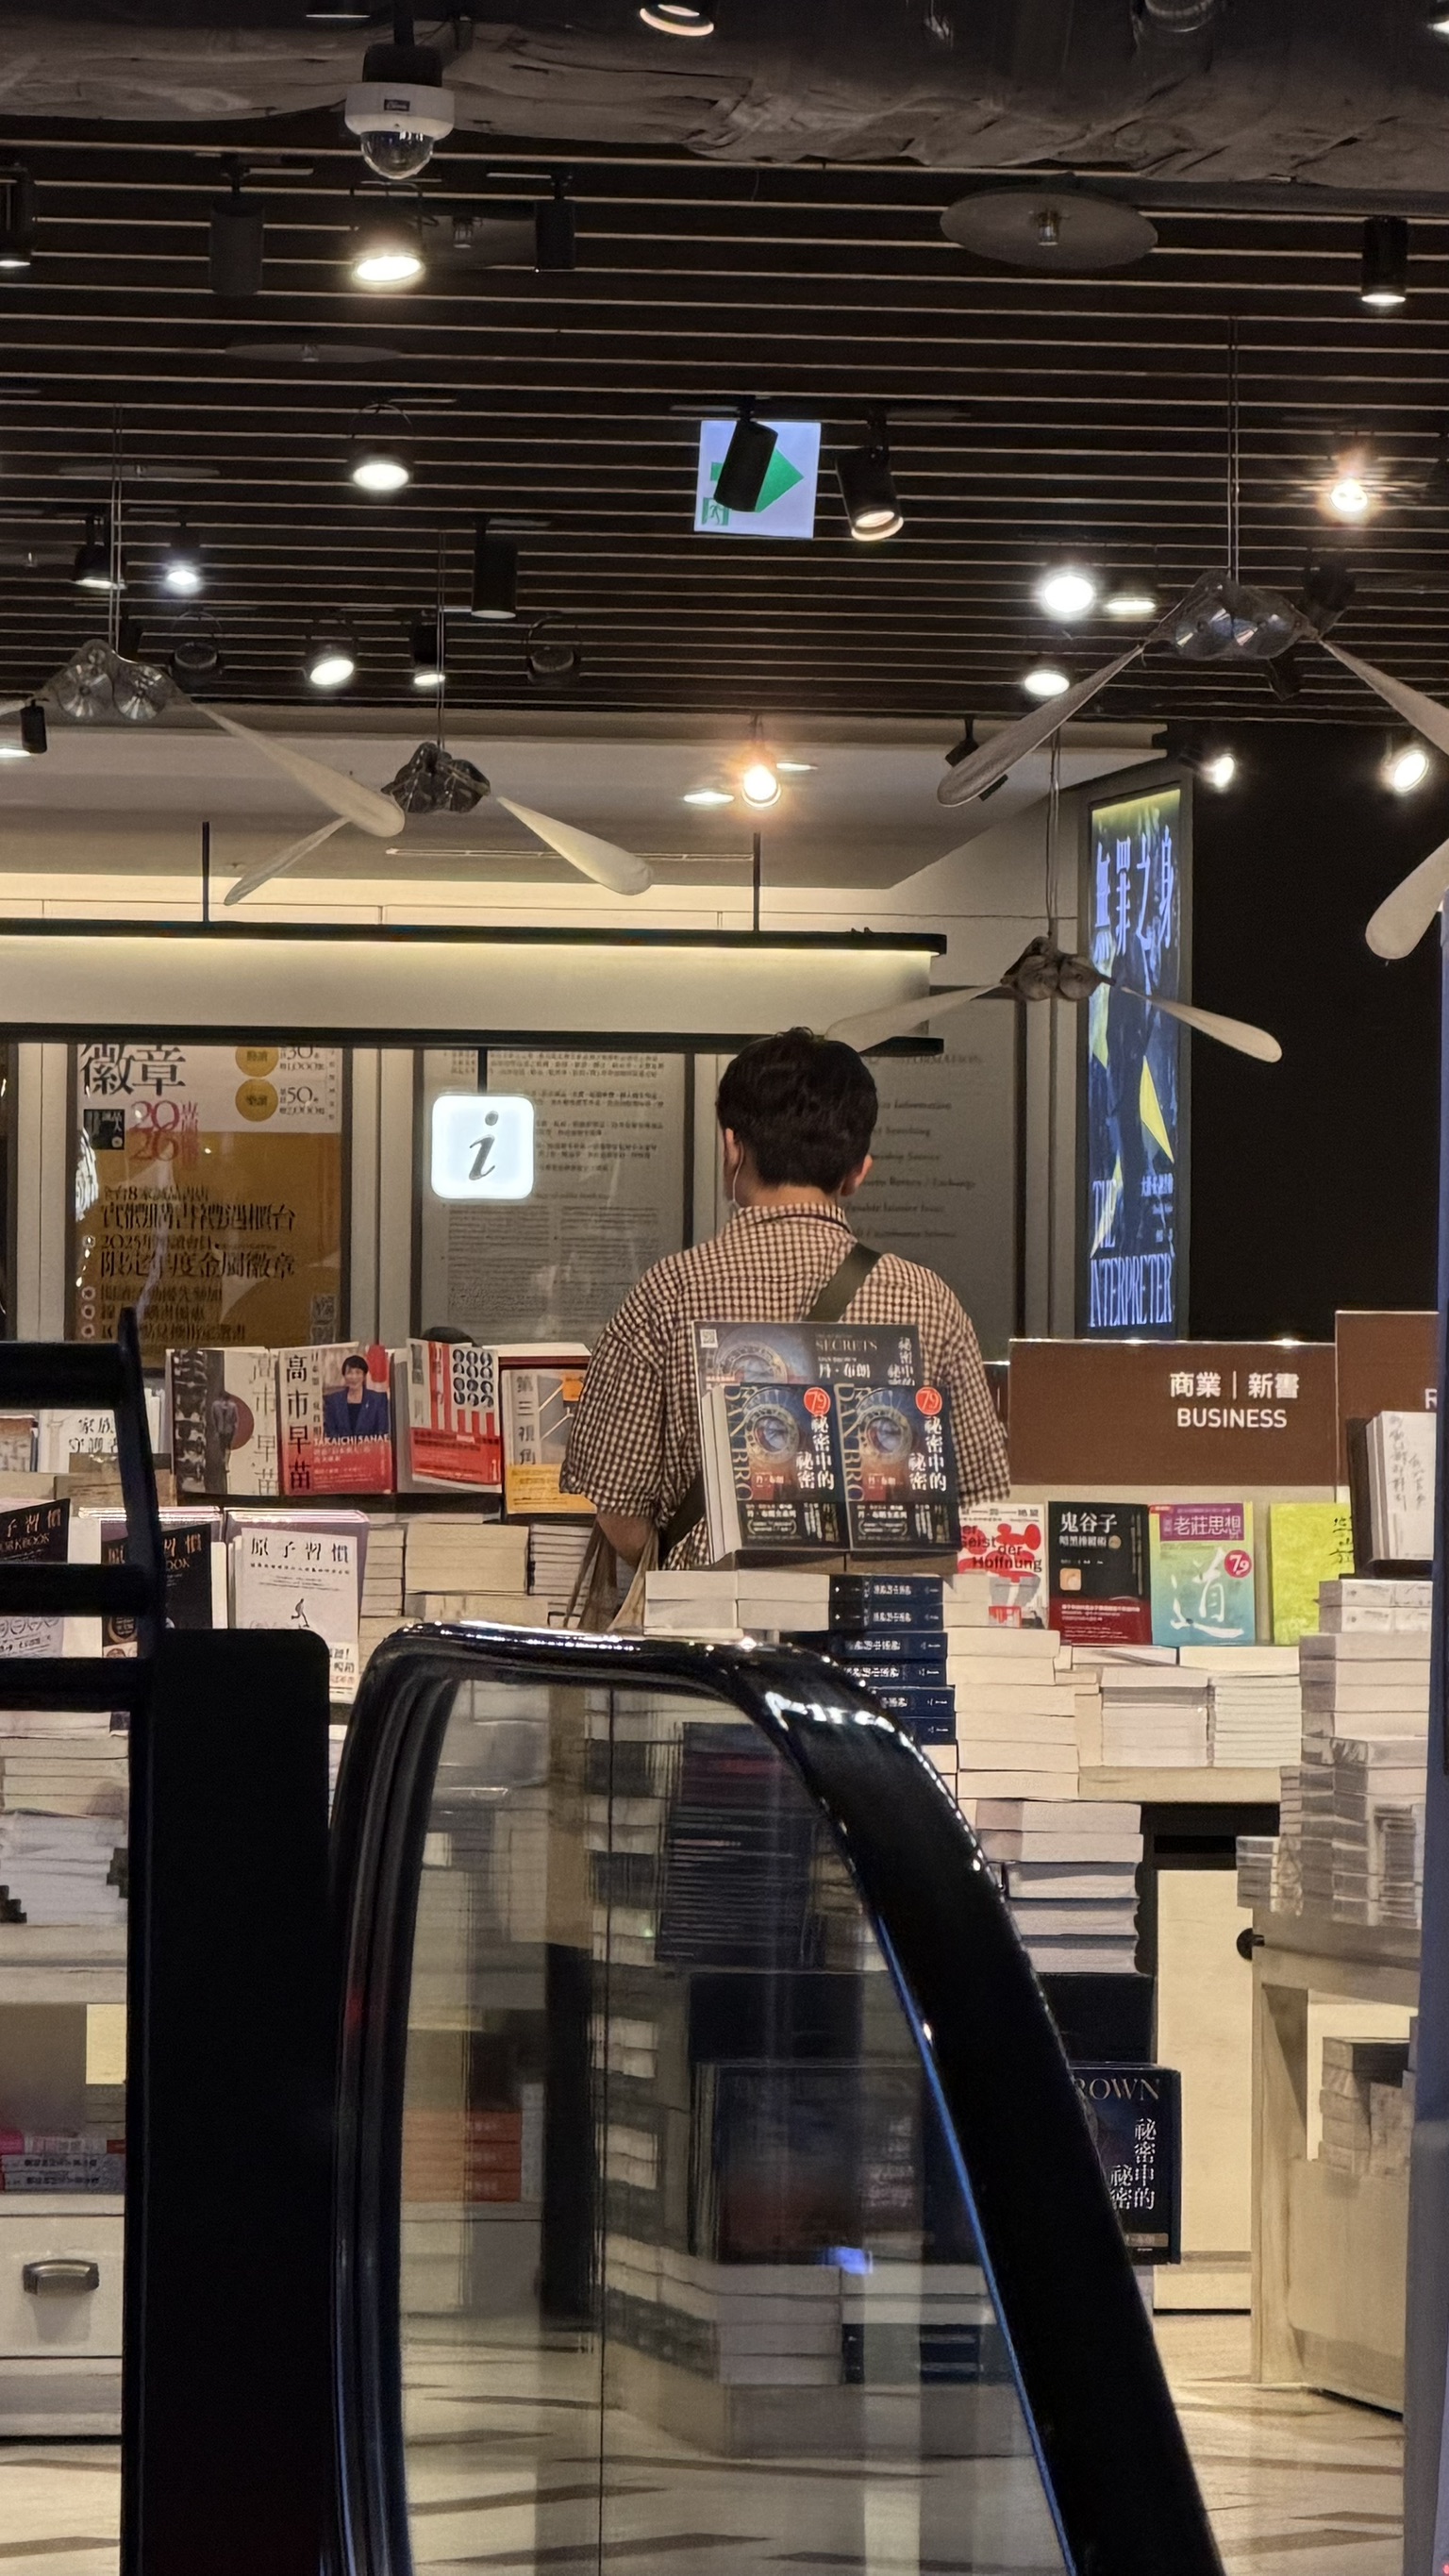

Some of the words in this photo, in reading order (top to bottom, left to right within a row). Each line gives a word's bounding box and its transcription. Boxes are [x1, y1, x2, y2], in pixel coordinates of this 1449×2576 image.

[1090, 1253, 1174, 1328] INTERPRETER
[1170, 1372, 1222, 1398] 商業
[1248, 1373, 1300, 1399] 新書
[286, 1354, 311, 1490] 高市早苗
[1177, 1408, 1288, 1428] BUSINESS
[1059, 1512, 1118, 1534] 鬼谷子
[1174, 1514, 1242, 1536] 老莊思想
[998, 1544, 1024, 1556] der
[973, 1556, 1042, 1573] Hoffnung
